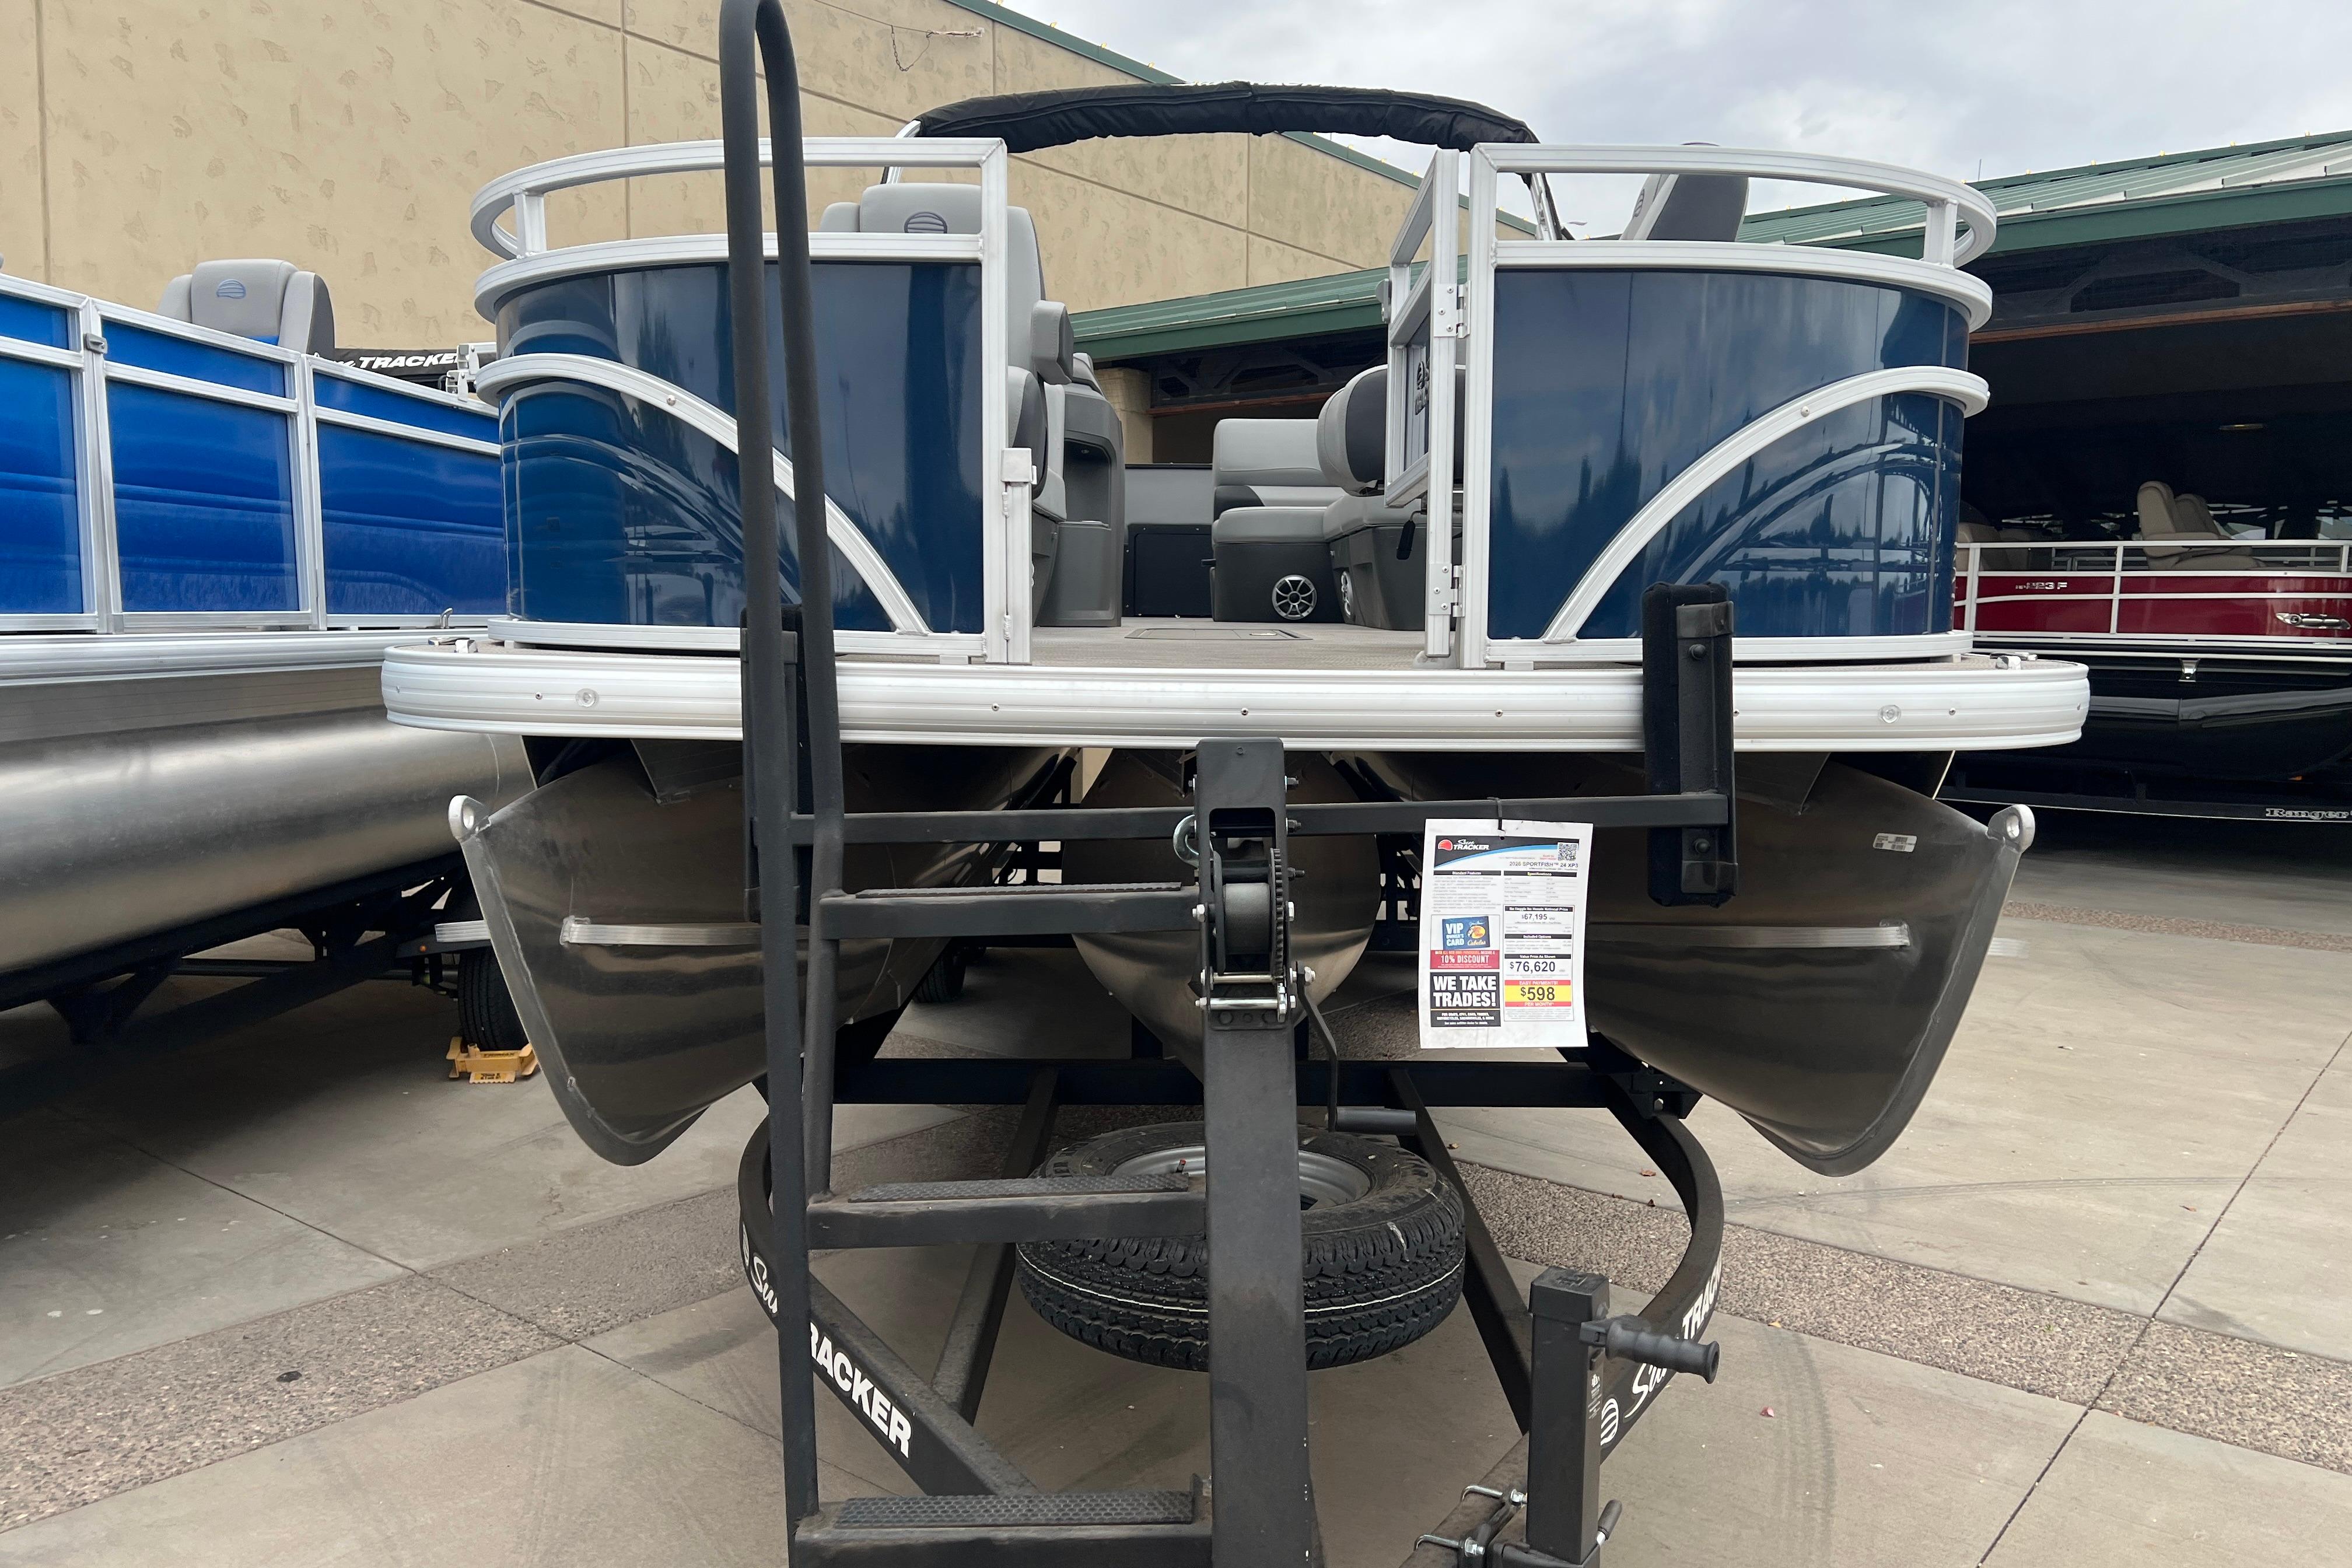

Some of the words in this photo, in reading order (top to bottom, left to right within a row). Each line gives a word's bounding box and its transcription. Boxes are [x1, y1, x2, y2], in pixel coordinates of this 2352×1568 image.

[2265, 808, 2349, 820] Ranger
[1446, 923, 1464, 935] VIP
[1441, 955, 1455, 964] 10%
[1457, 955, 1489, 964] DISCOUNT
[1510, 961, 1556, 974] $76,620
[1433, 975, 1457, 991] WE
[1459, 975, 1497, 991] TAKE
[1433, 992, 1496, 1007] TRADES!
[1520, 986, 1555, 1001] $598
[810, 1322, 912, 1458] RACKER
